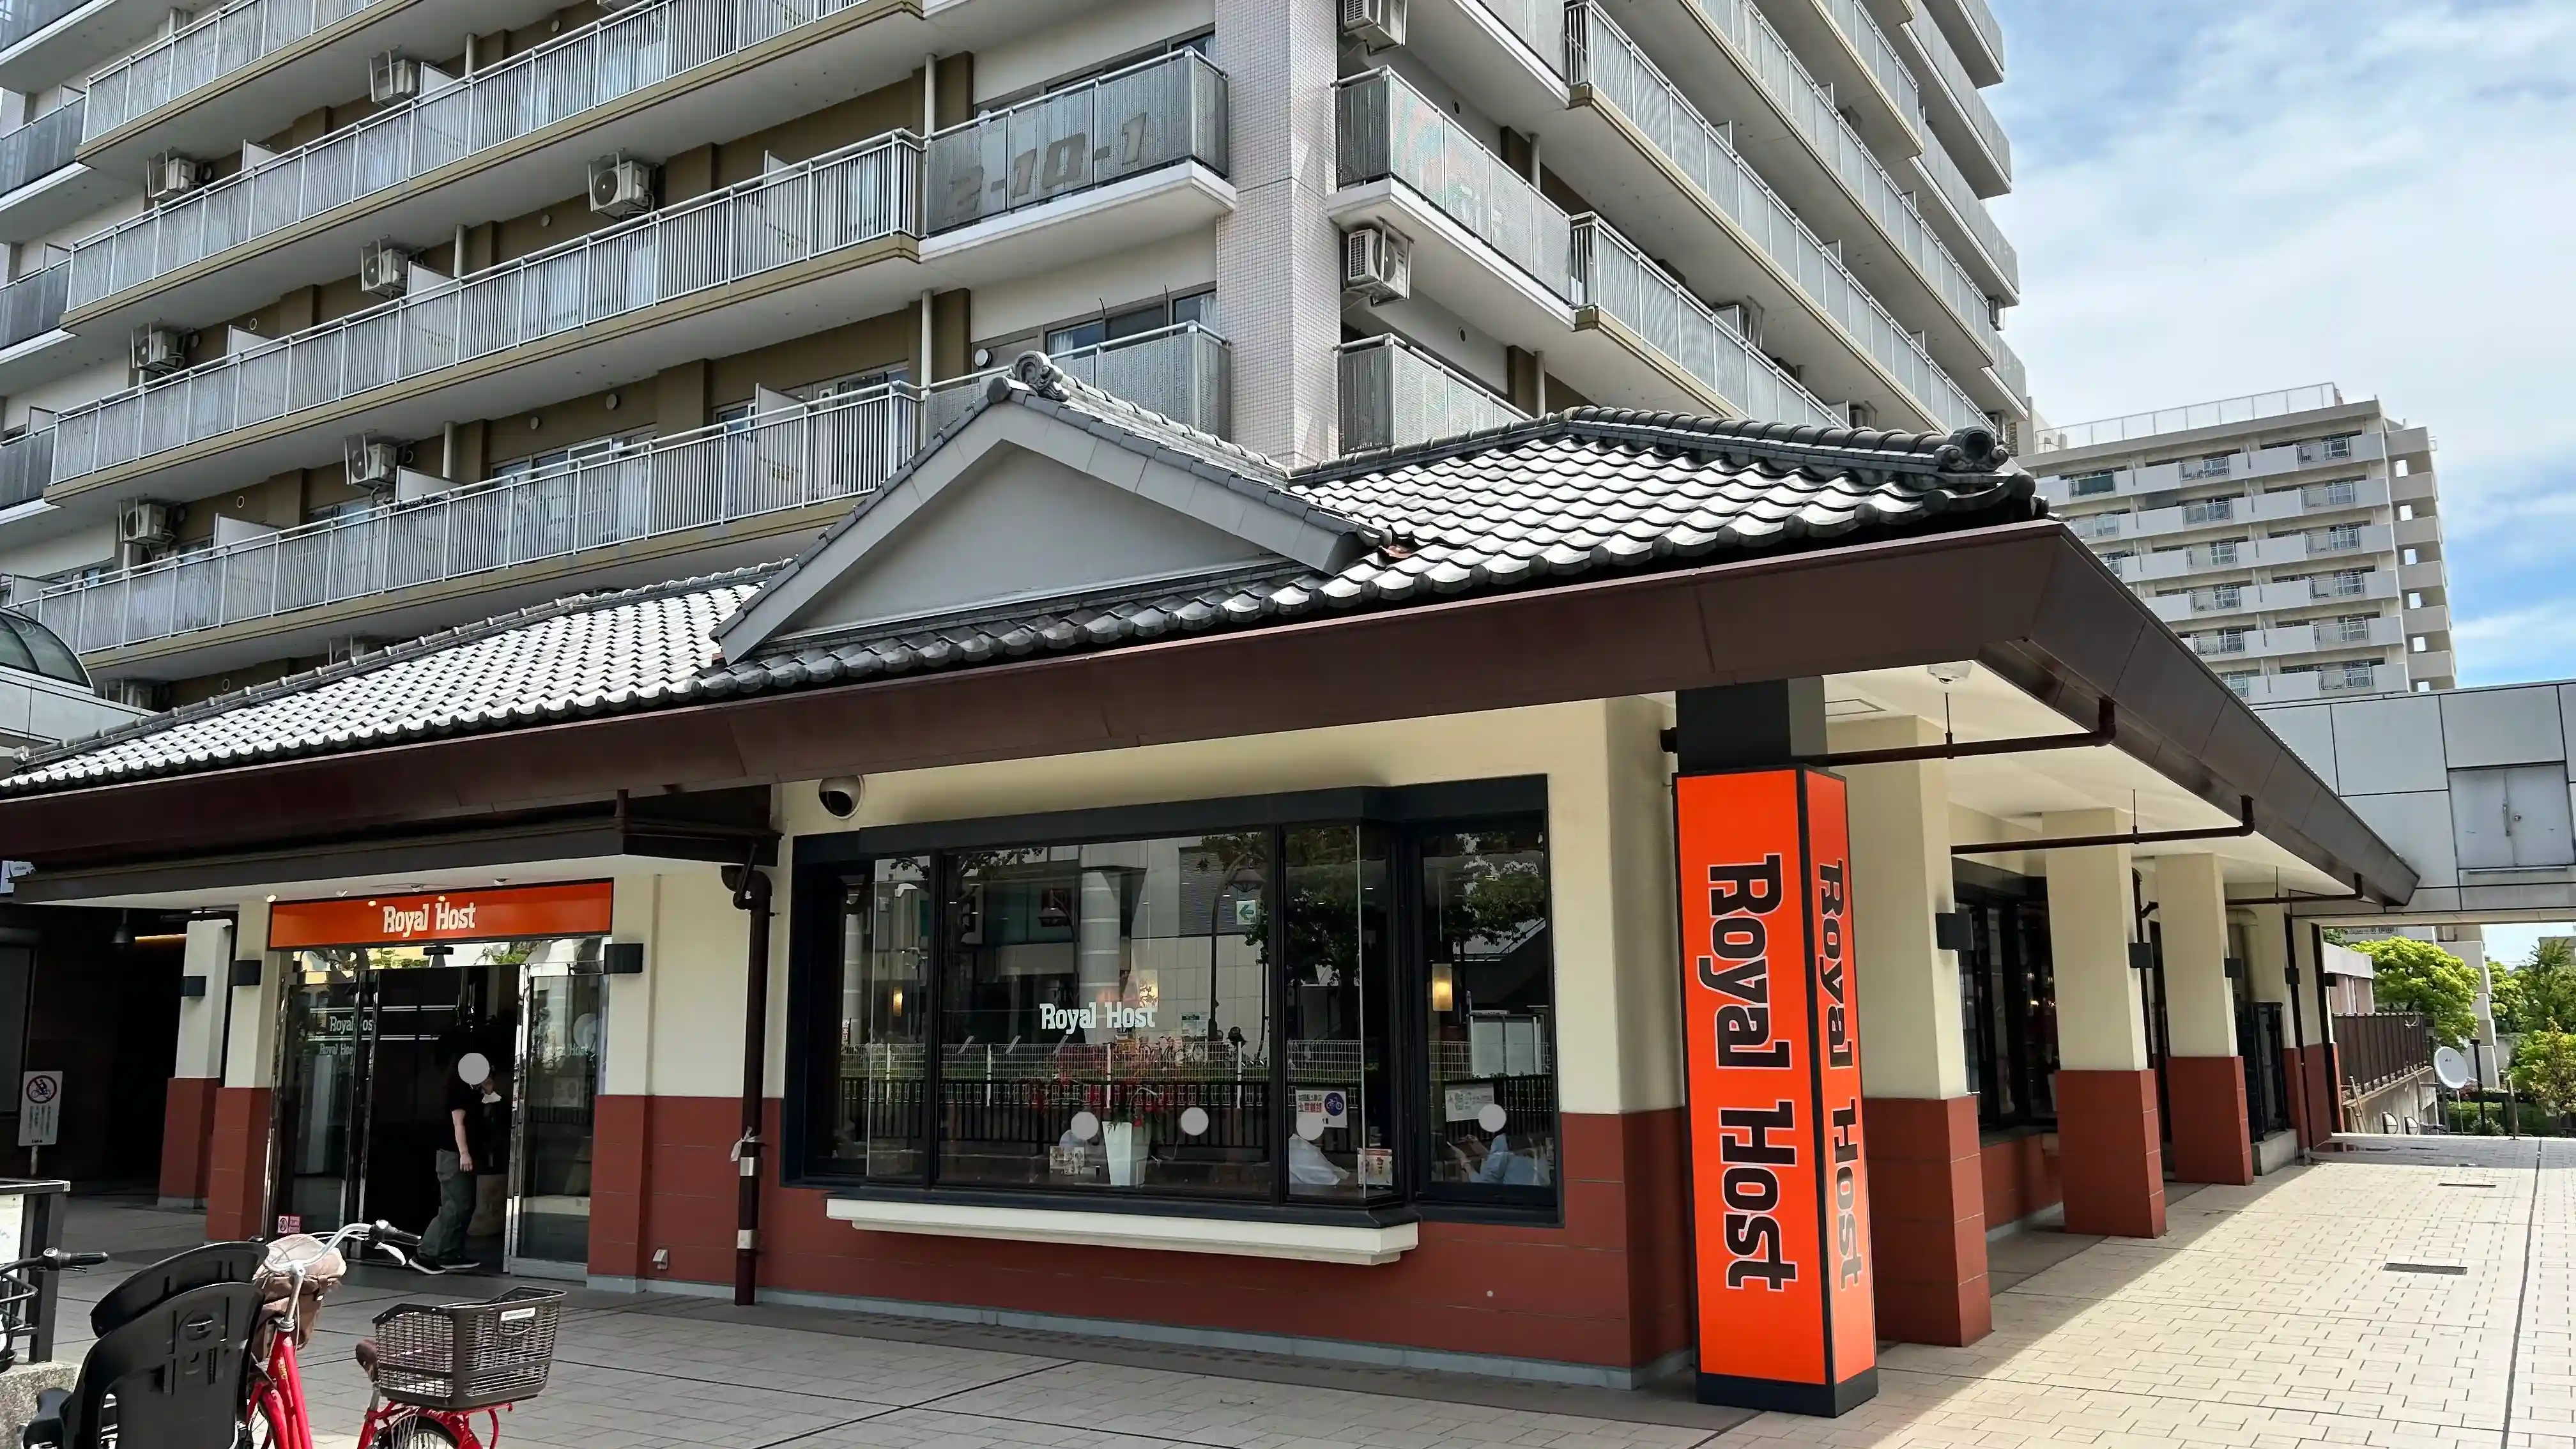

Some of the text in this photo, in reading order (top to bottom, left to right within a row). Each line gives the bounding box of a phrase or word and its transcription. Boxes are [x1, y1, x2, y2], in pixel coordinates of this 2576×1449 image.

[942, 112, 1147, 225] 2-10-1
[383, 901, 476, 937] Royal Host
[330, 1015, 355, 1034] Royal
[1039, 1001, 1158, 1034] Royal Host
[1697, 852, 1798, 1292] Royal Host
[1818, 858, 1863, 1292] Royal Host
